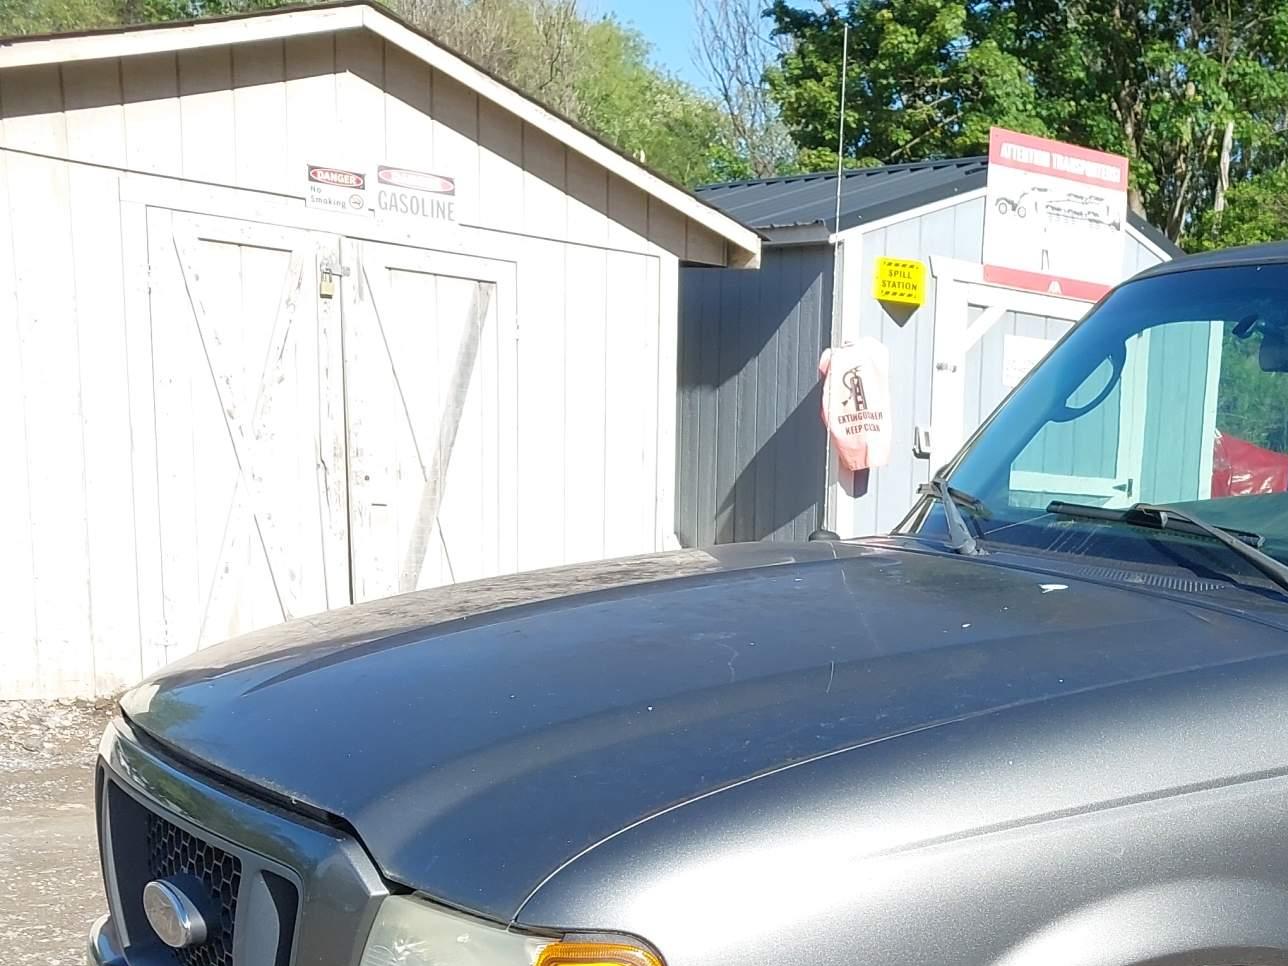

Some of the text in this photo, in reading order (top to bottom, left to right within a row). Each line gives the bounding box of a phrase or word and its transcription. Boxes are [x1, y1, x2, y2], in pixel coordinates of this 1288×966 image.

[316, 169, 356, 186] DANGER
[310, 185, 322, 194] No
[310, 194, 347, 210] Smoking
[377, 189, 456, 222] GASOLINE
[888, 269, 912, 280] SPILL
[881, 279, 918, 291] STATION
[845, 424, 863, 436] KEEP
